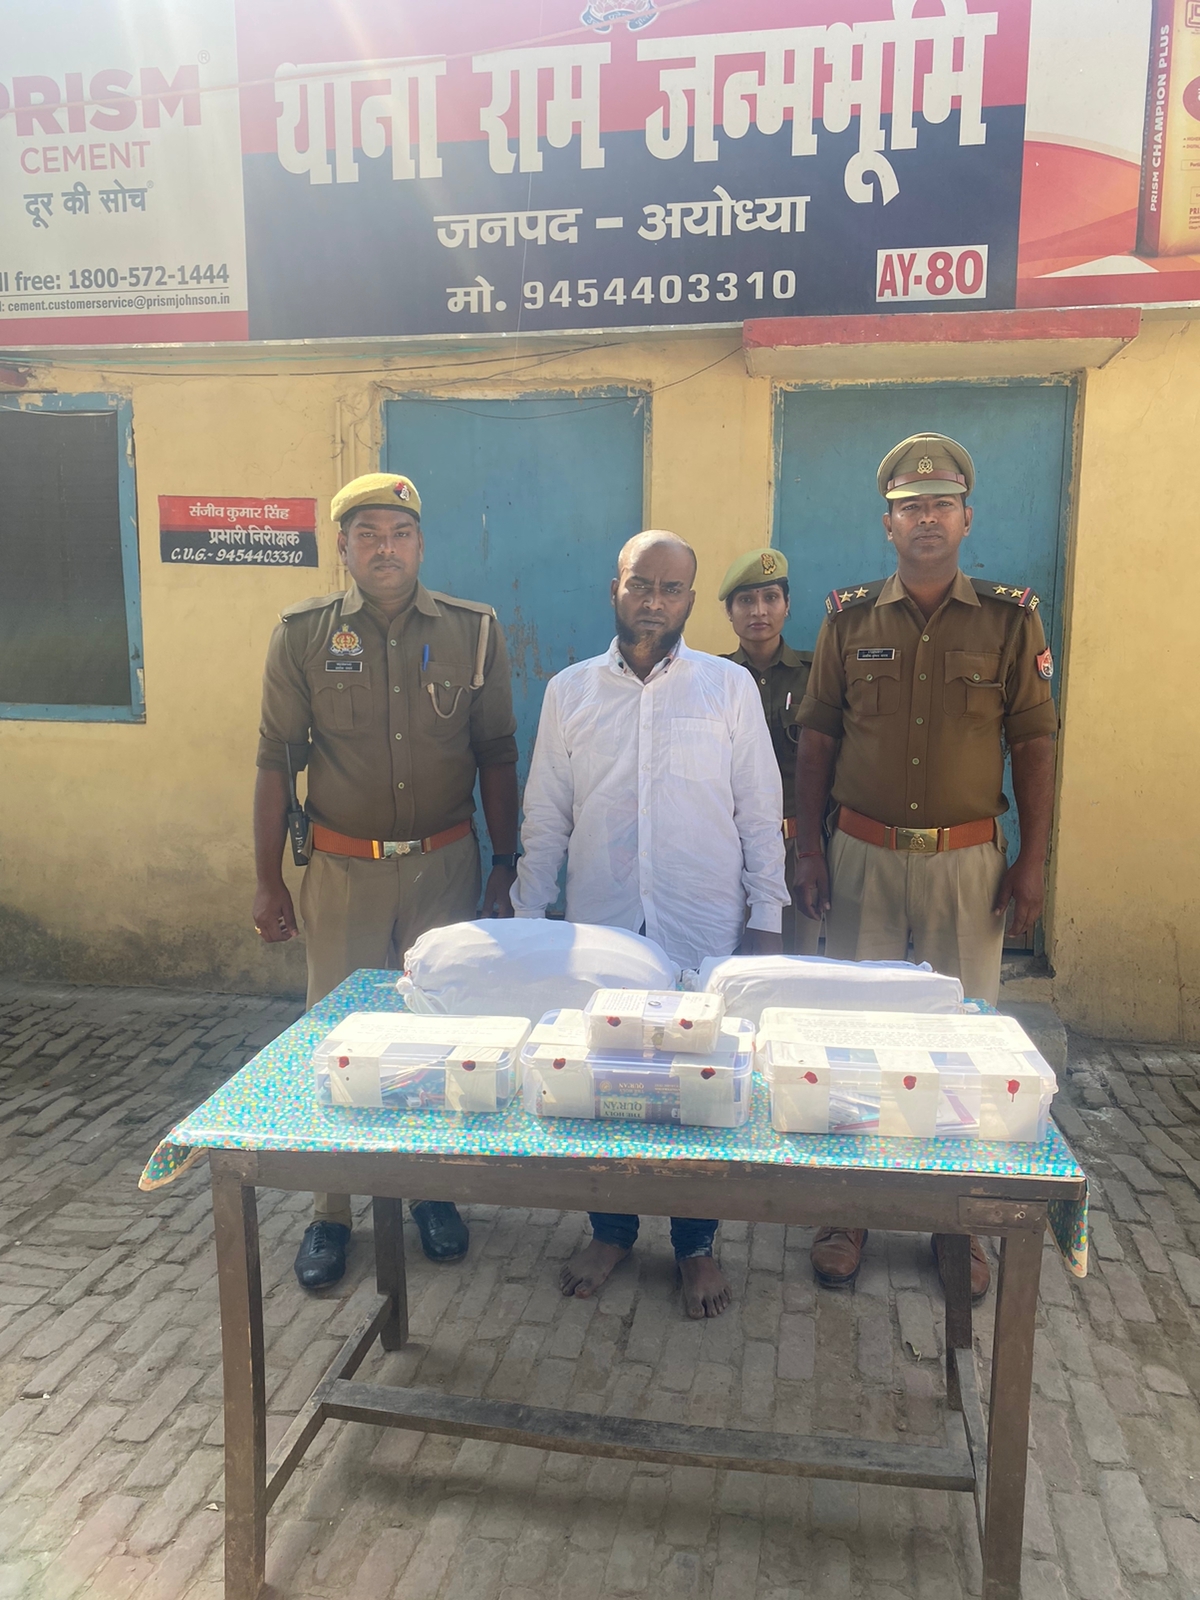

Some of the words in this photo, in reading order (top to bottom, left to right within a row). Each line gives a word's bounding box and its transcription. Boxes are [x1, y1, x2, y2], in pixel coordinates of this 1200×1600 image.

[1158, 24, 1170, 69] PLUS
[0, 65, 201, 136] RISM
[274, 54, 446, 185] थाना
[472, 42, 611, 174] राम
[636, 0, 998, 206] जन्मभूमि
[1152, 74, 1167, 168] CHAMPION
[20, 141, 151, 174] CEMENT
[23, 193, 53, 229] दूर
[61, 181, 91, 214] की
[99, 179, 148, 213] सोच
[1150, 171, 1160, 212] PRISM
[433, 208, 584, 249] जनपद
[637, 185, 811, 242] अयोध्या
[15, 271, 61, 291] free:
[69, 263, 229, 290] 1800-572-1444
[445, 275, 507, 314] मो.
[522, 269, 796, 310] 9454403310
[878, 250, 984, 298] AY-80
[8, 293, 230, 312] cement.customerservice@prismjohnson.in
[189, 502, 225, 518] संजीव
[226, 505, 262, 522] कुमार
[263, 504, 290, 519] सिंह
[208, 525, 247, 545] प्रभारी
[248, 525, 299, 548] निरीक्षक
[215, 548, 303, 564] 9454403310
